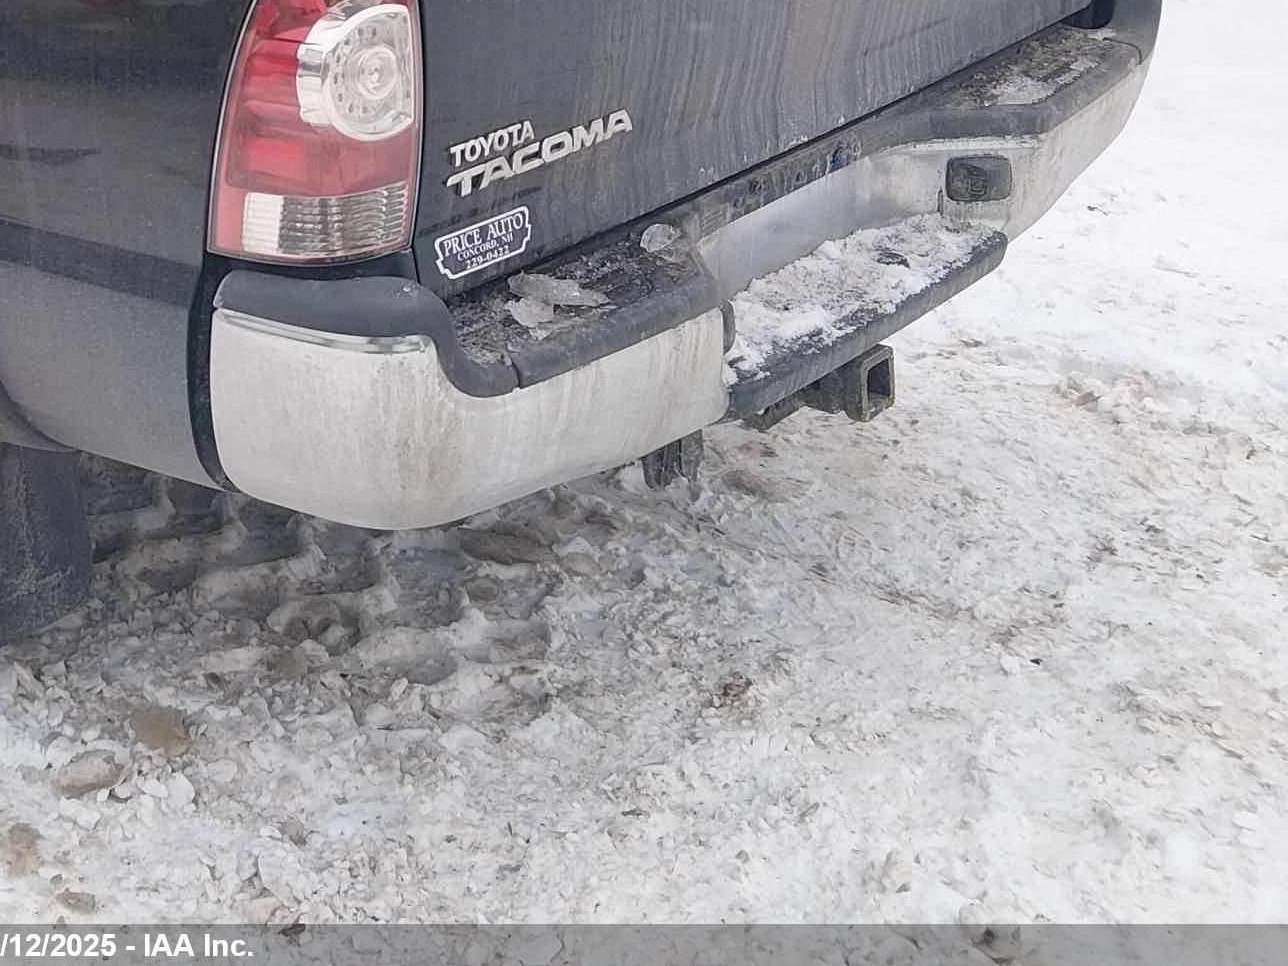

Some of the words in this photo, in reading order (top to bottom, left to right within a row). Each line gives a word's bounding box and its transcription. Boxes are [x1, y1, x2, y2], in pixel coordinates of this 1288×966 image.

[446, 108, 633, 198] TACOMA
[449, 120, 536, 168] TOYOTA
[442, 228, 483, 258] PRICE
[486, 212, 524, 241] AUTO
[465, 245, 510, 270] 229-0422
[501, 232, 514, 244] NH
